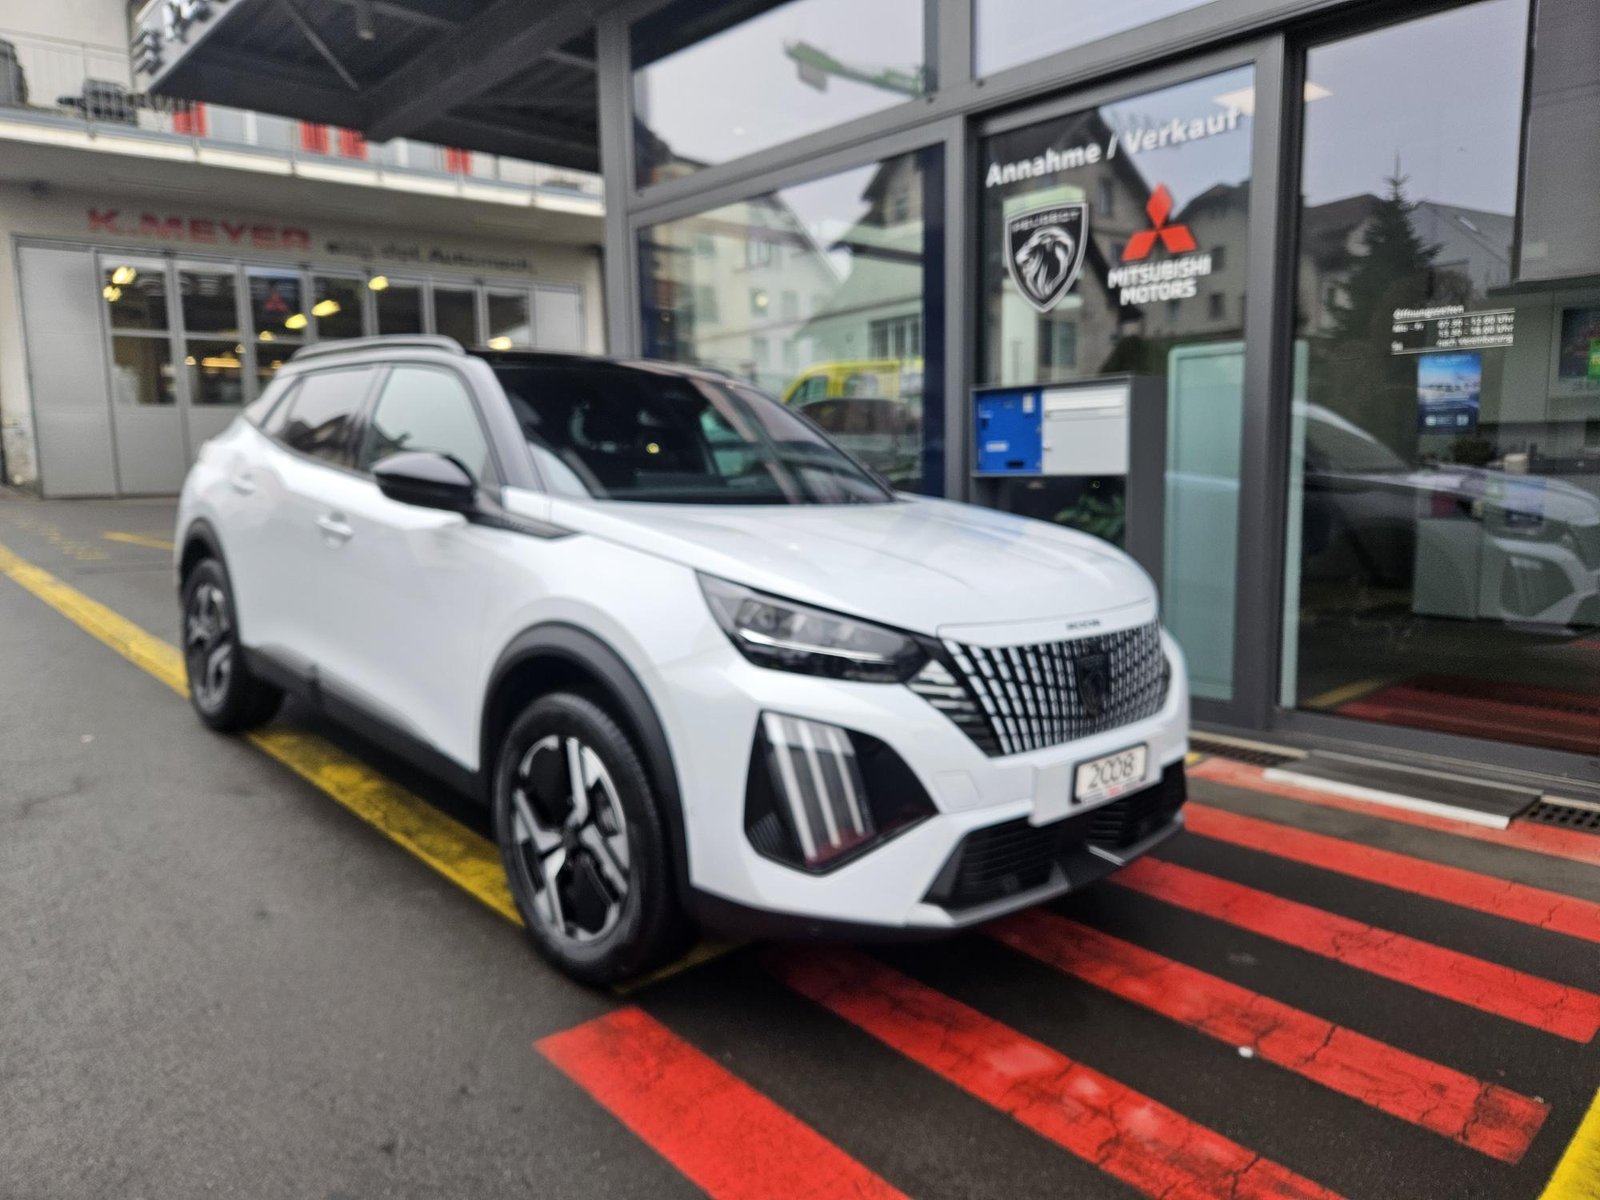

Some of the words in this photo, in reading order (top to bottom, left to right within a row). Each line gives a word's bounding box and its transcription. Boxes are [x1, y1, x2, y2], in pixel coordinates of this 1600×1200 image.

[985, 143, 1101, 188] Annahme
[1106, 133, 1119, 161] /
[1125, 107, 1240, 154] Verkauf
[1108, 254, 1212, 288] MITSUBISHI
[1120, 278, 1197, 306] MOTORS
[1087, 752, 1135, 789] 2008
